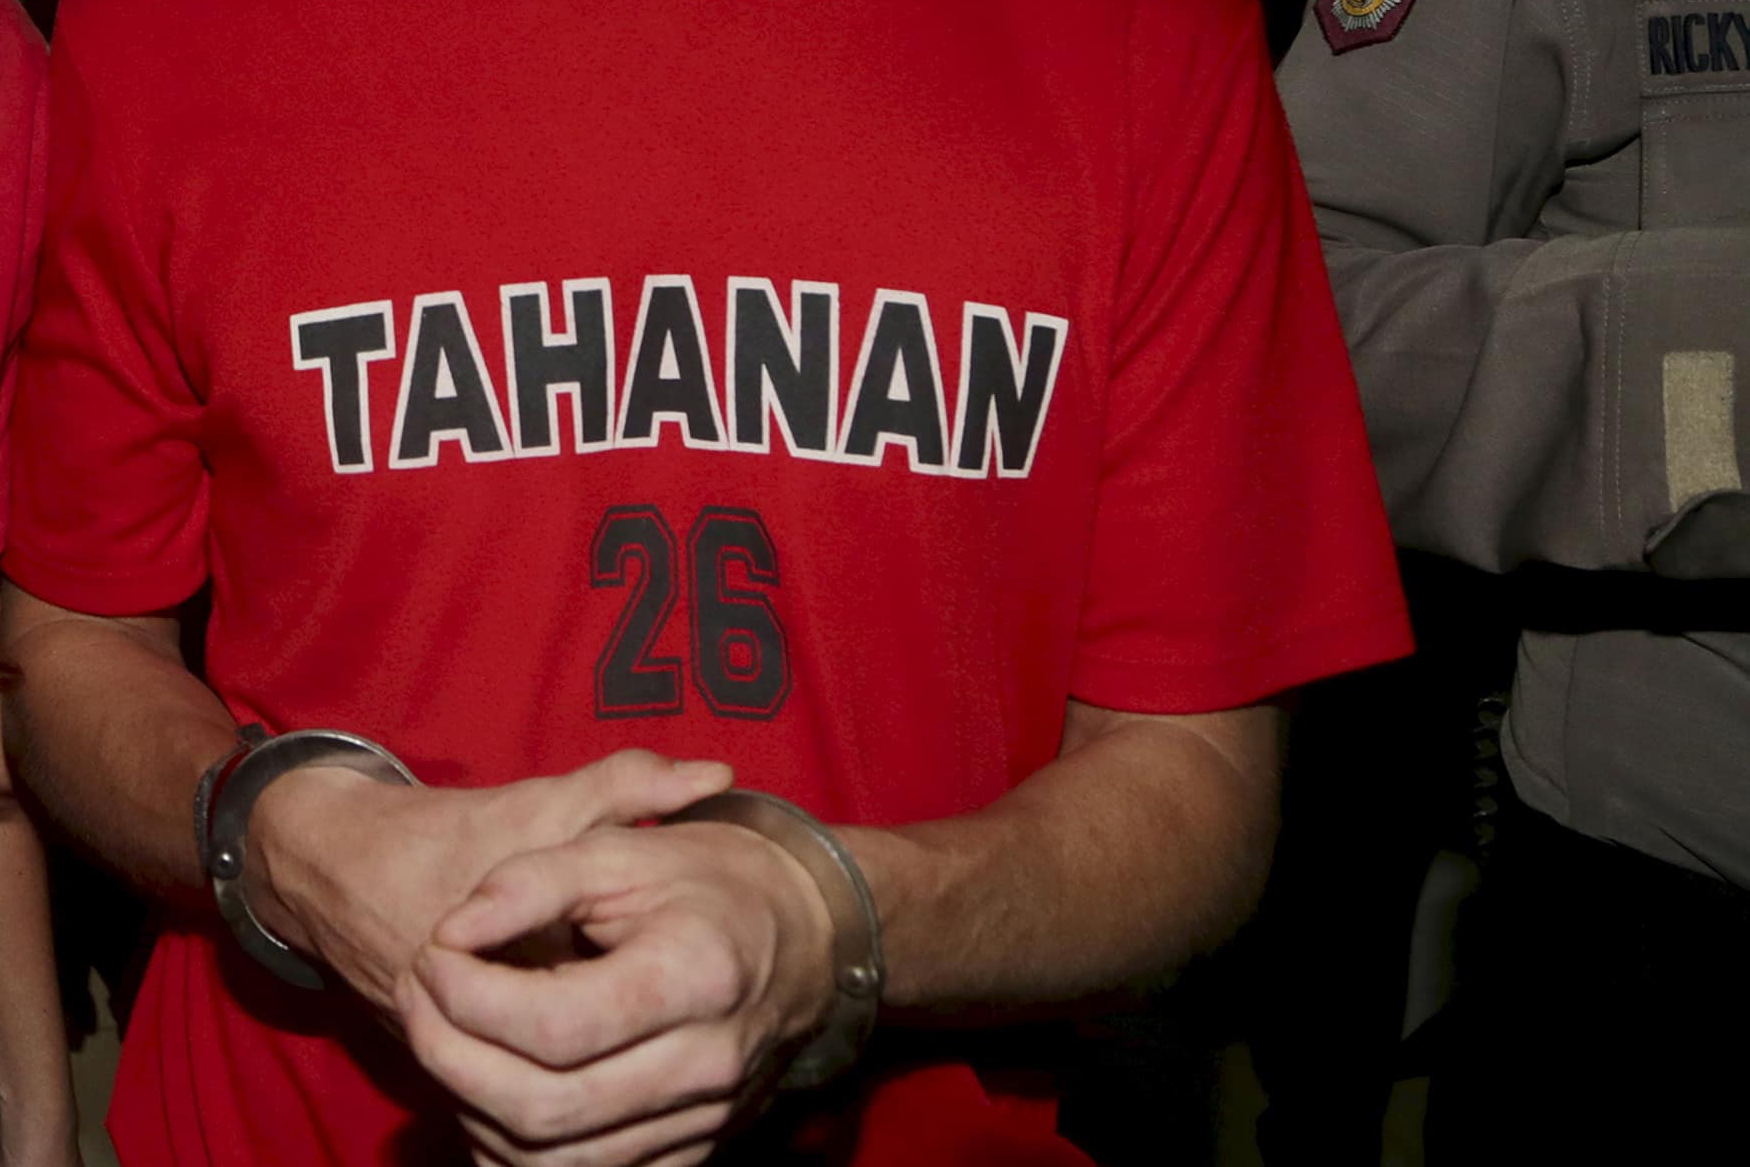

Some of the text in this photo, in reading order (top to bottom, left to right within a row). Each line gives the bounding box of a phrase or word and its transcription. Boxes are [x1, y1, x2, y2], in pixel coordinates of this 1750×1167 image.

[1648, 12, 1750, 75] RICKY
[289, 274, 1069, 480] TAHANAN
[590, 504, 793, 721] 26
